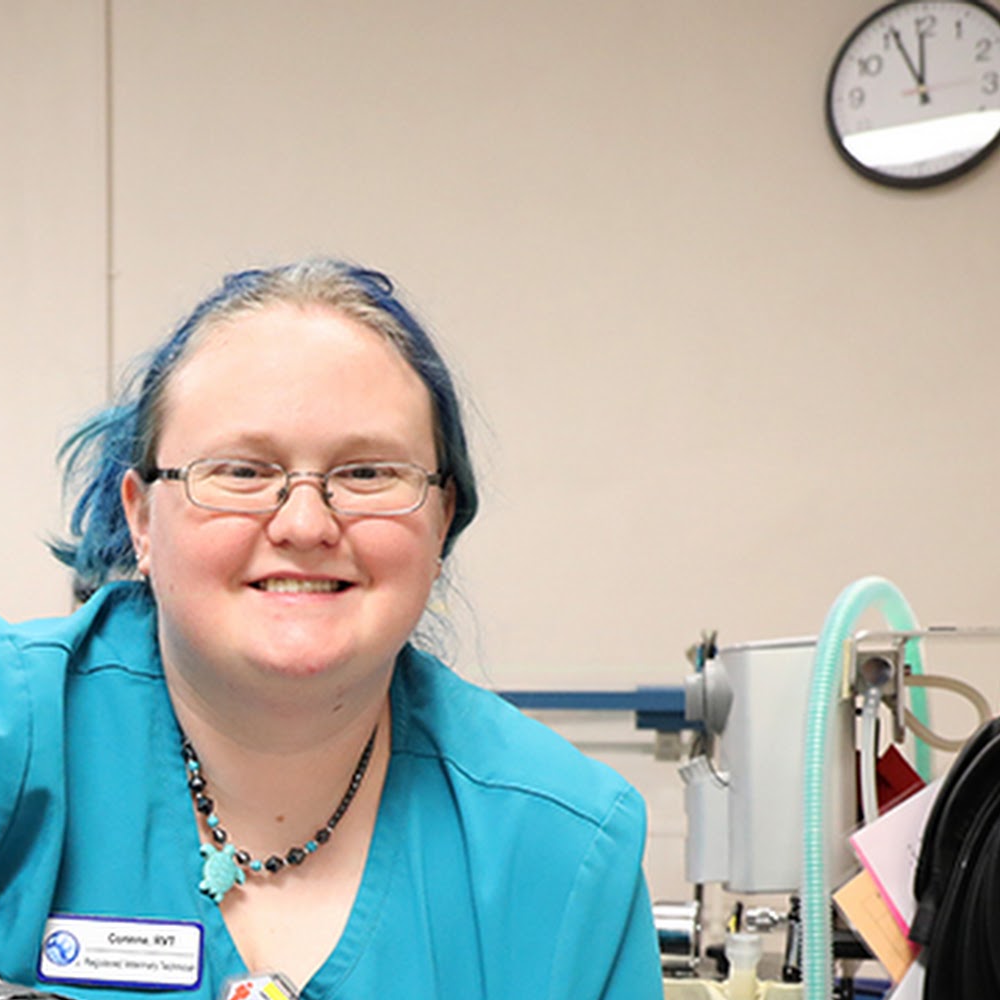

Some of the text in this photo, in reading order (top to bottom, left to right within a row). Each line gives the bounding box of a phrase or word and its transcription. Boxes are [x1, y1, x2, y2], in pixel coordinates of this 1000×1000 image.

[954, 19, 964, 39] 1
[975, 38, 992, 62] 2
[857, 54, 883, 77] 10
[982, 72, 1000, 95] 3
[850, 87, 866, 109] 9
